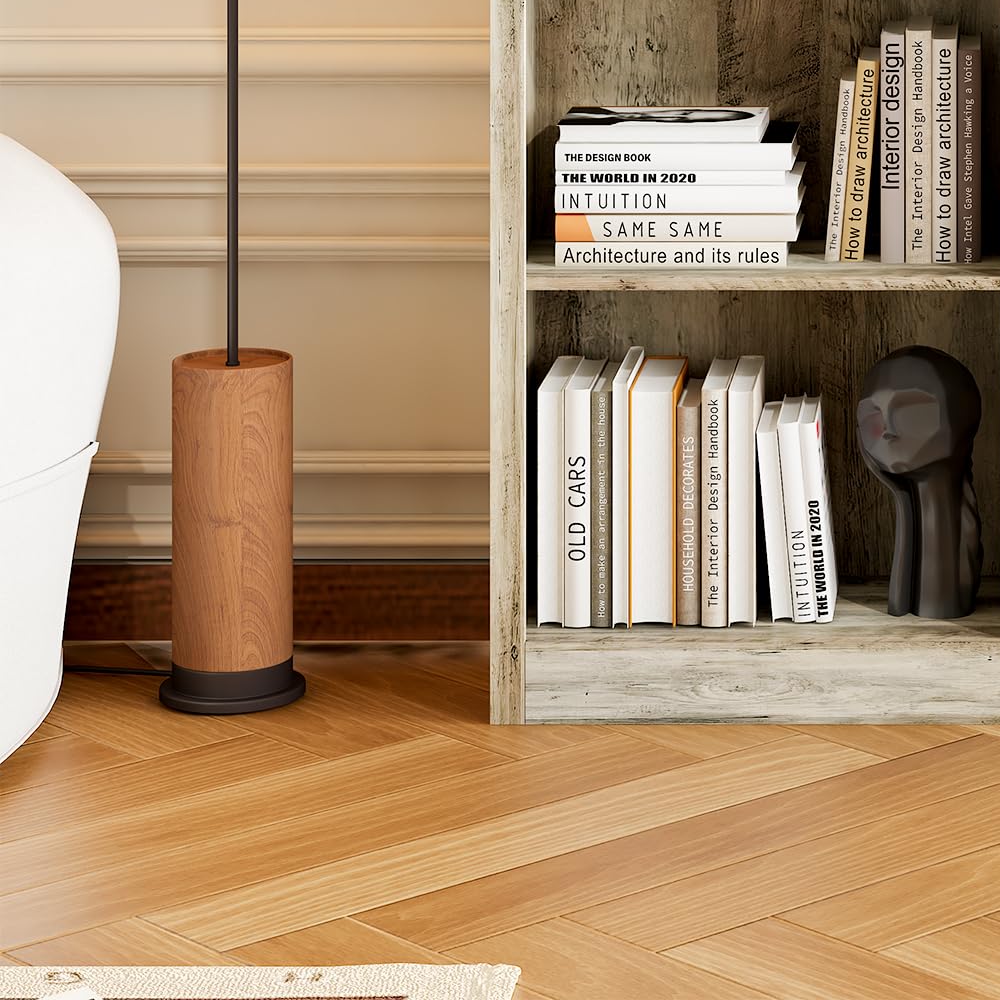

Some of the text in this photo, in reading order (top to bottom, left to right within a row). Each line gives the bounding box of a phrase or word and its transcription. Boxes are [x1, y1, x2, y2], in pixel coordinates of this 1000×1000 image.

[964, 55, 972, 82] Voice
[882, 44, 904, 189] Interior design
[912, 41, 925, 250] The Interior Design Handbook
[964, 99, 974, 137] Hawking
[562, 174, 696, 183] THE WORLD IN 2020
[845, 69, 874, 260] How to draw architecture
[936, 49, 952, 263] How to draw architecture
[964, 143, 974, 181] Stephen
[563, 194, 665, 209] INTUITION
[963, 216, 972, 241] Intel
[964, 187, 972, 209] Gave
[563, 248, 779, 263] Architecture and its rules
[604, 222, 722, 237] SAME SAME
[964, 248, 972, 264] How
[568, 455, 586, 561] OLD CARS
[598, 396, 607, 617] How to make an arrangement in the house
[683, 436, 694, 591] HOUSEHOLD DECORATES
[708, 400, 721, 607] The Interior Design Handbook
[792, 531, 809, 618] INTUITION
[808, 500, 829, 617] THE WORLD IN 2020
